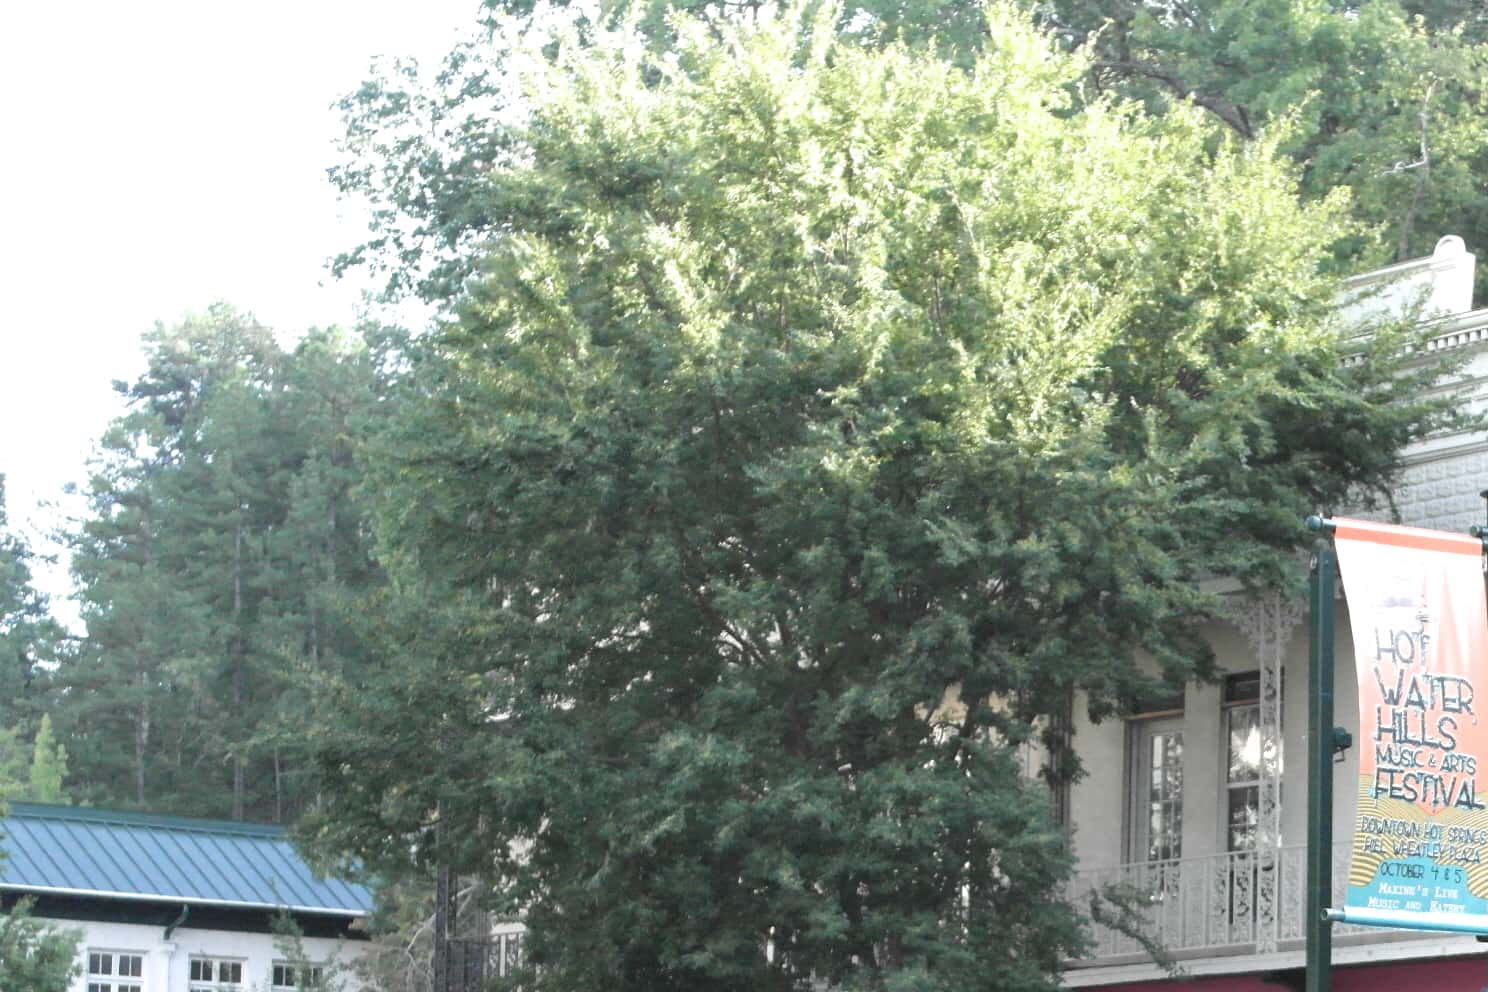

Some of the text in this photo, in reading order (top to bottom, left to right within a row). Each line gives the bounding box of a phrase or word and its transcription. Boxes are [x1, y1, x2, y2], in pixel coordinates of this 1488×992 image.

[1373, 667, 1475, 716] WATER
[1374, 706, 1458, 750] HILLS
[1376, 743, 1478, 775] MUSIC & ARTS
[1374, 767, 1486, 810] FESTIVAL
[1360, 815, 1488, 845] DOWNTOWN HOT SPRINGS
[1380, 862, 1425, 880] OCTOBER
[1430, 866, 1439, 880] 4
[1454, 869, 1463, 884] 5
